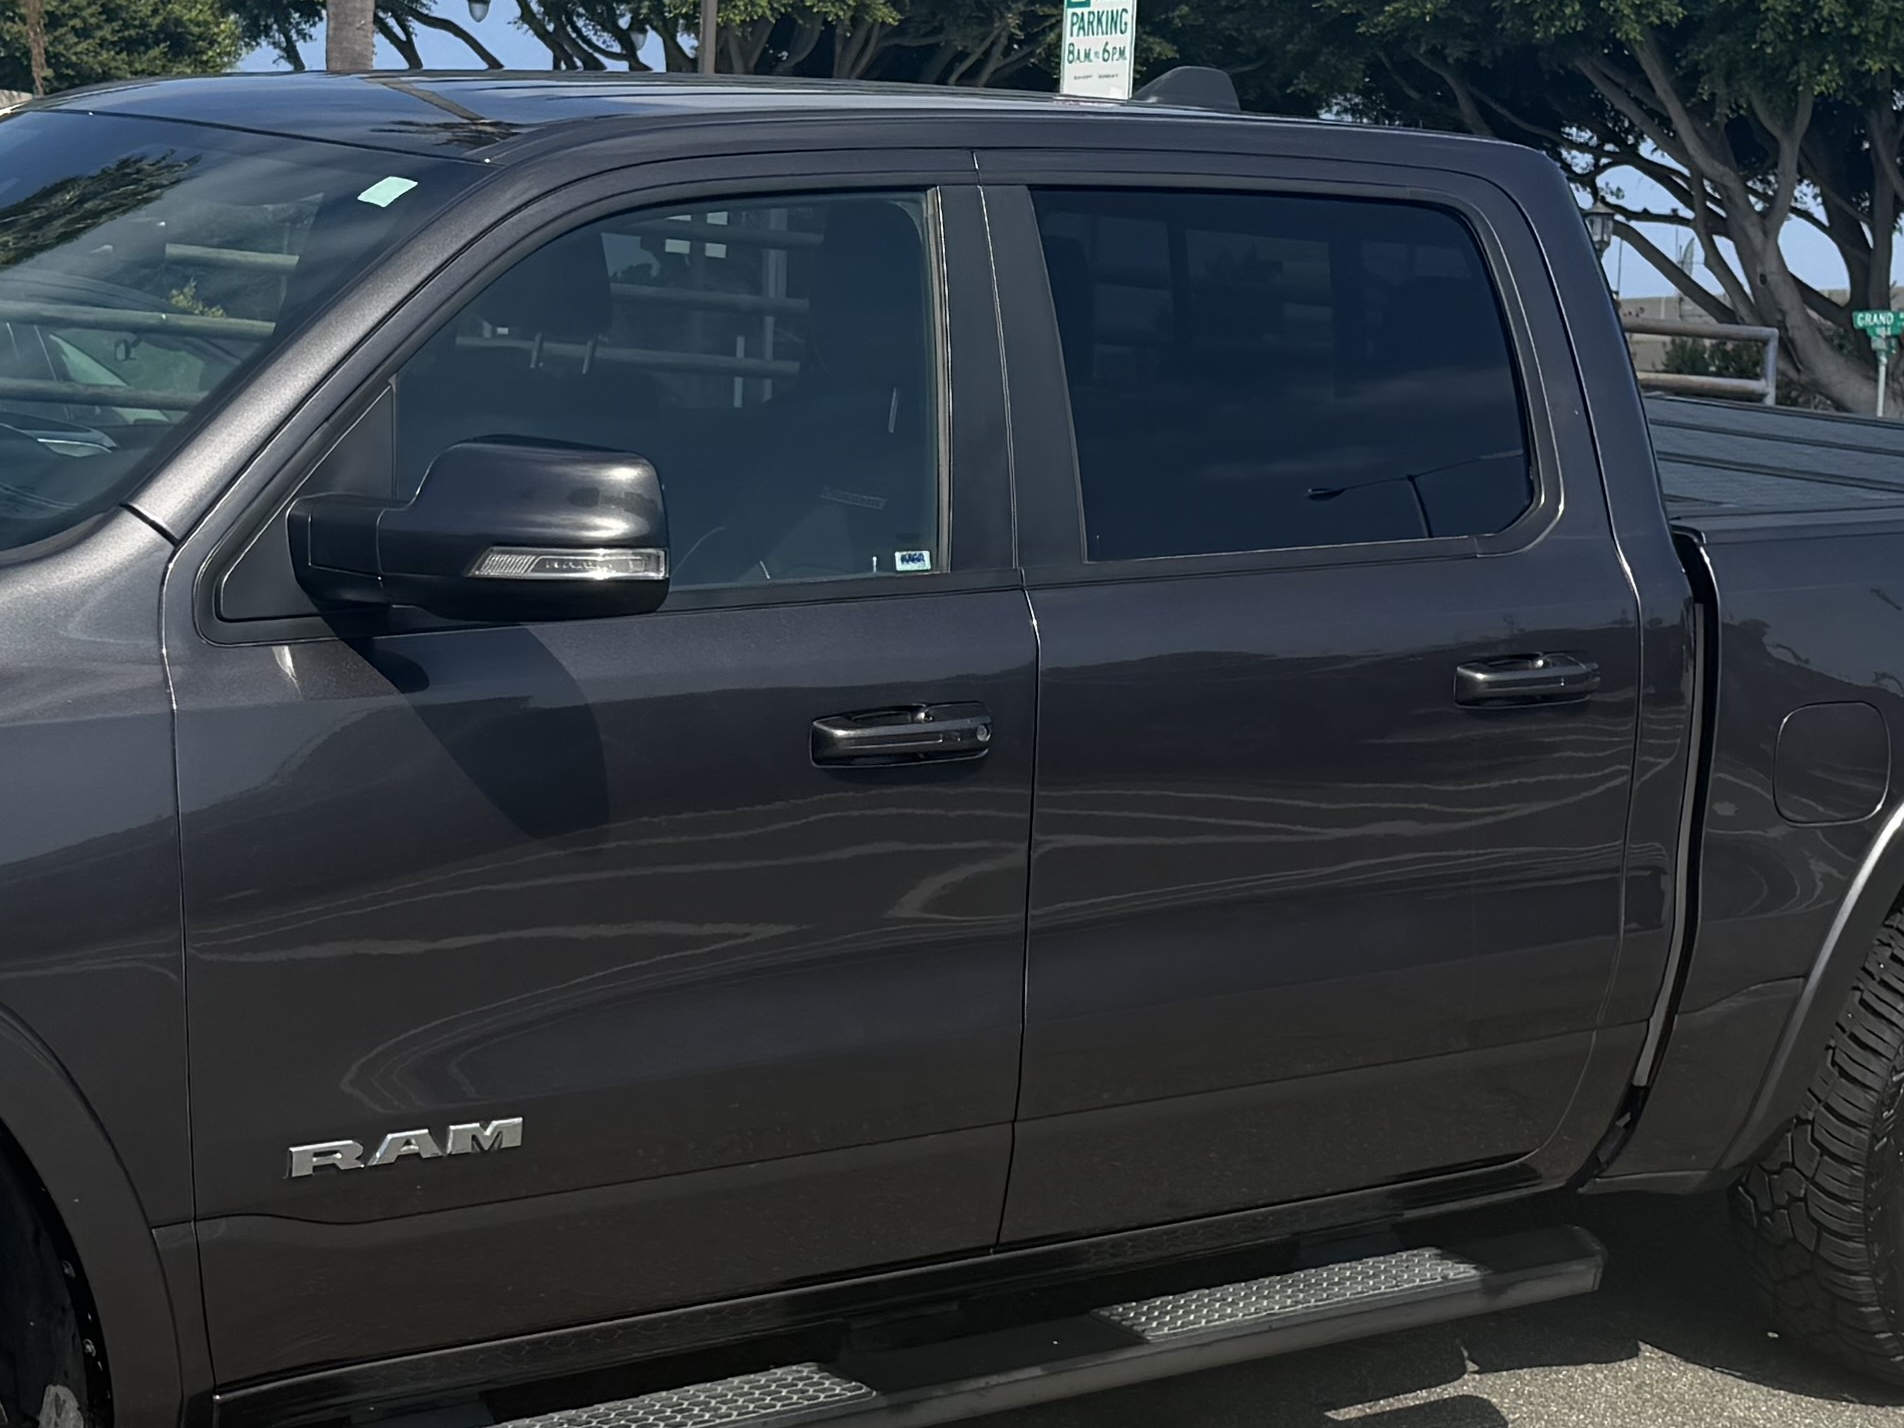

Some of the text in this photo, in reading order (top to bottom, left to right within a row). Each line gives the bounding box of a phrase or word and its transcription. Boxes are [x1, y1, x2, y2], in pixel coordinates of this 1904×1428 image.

[1070, 8, 1128, 37] PARKING
[1857, 312, 1894, 326] GRAND
[287, 1117, 523, 1177] RAM
